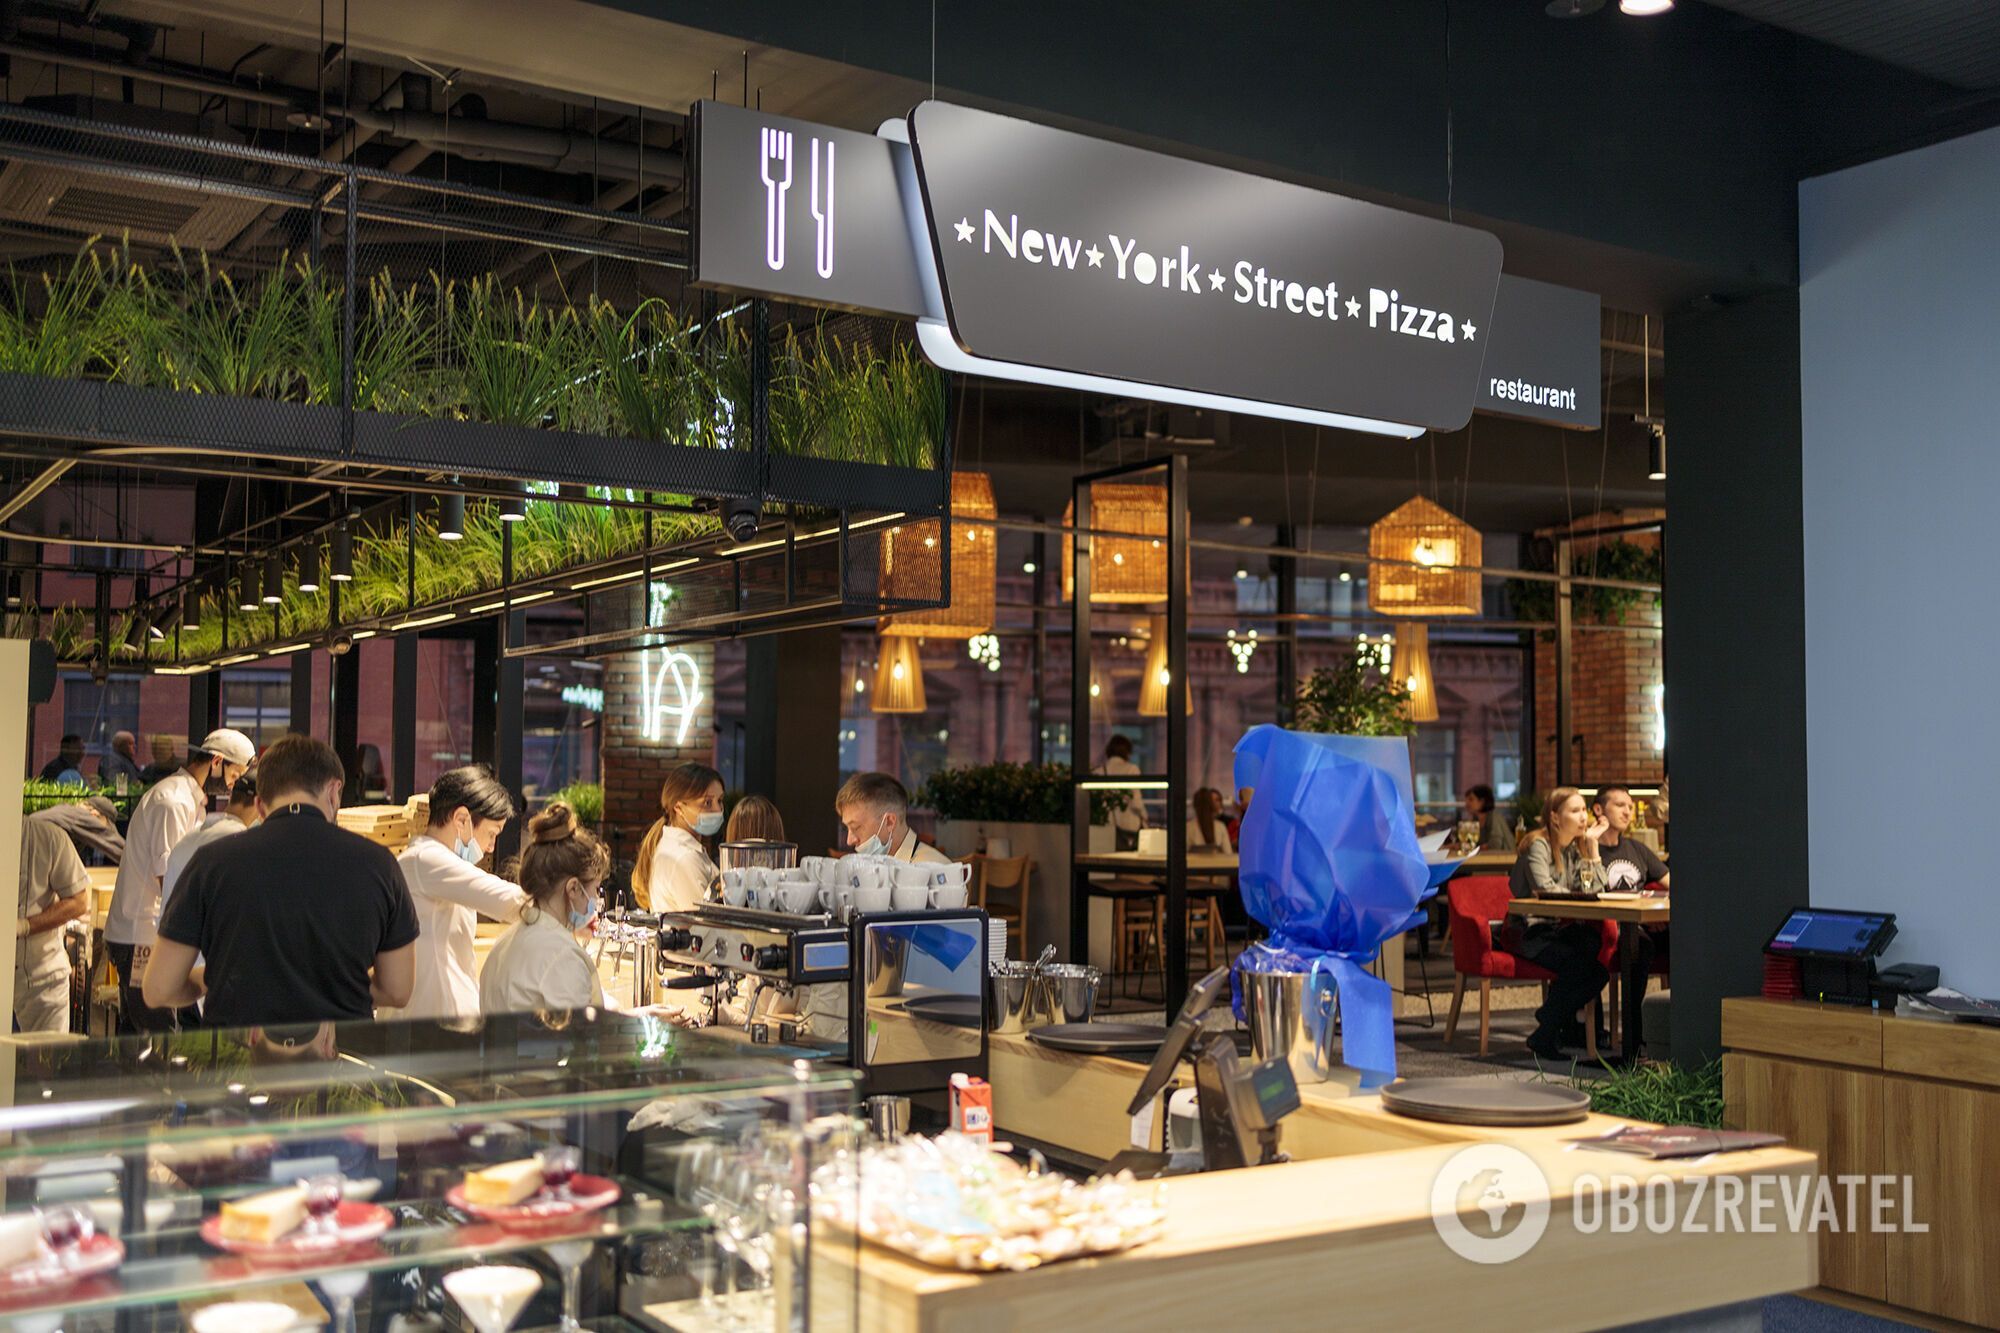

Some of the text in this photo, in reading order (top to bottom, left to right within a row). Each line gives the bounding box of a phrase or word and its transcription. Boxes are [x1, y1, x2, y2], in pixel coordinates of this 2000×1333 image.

[984, 208, 1455, 344] New York Street Pizza
[1490, 377, 1576, 411] restaurant
